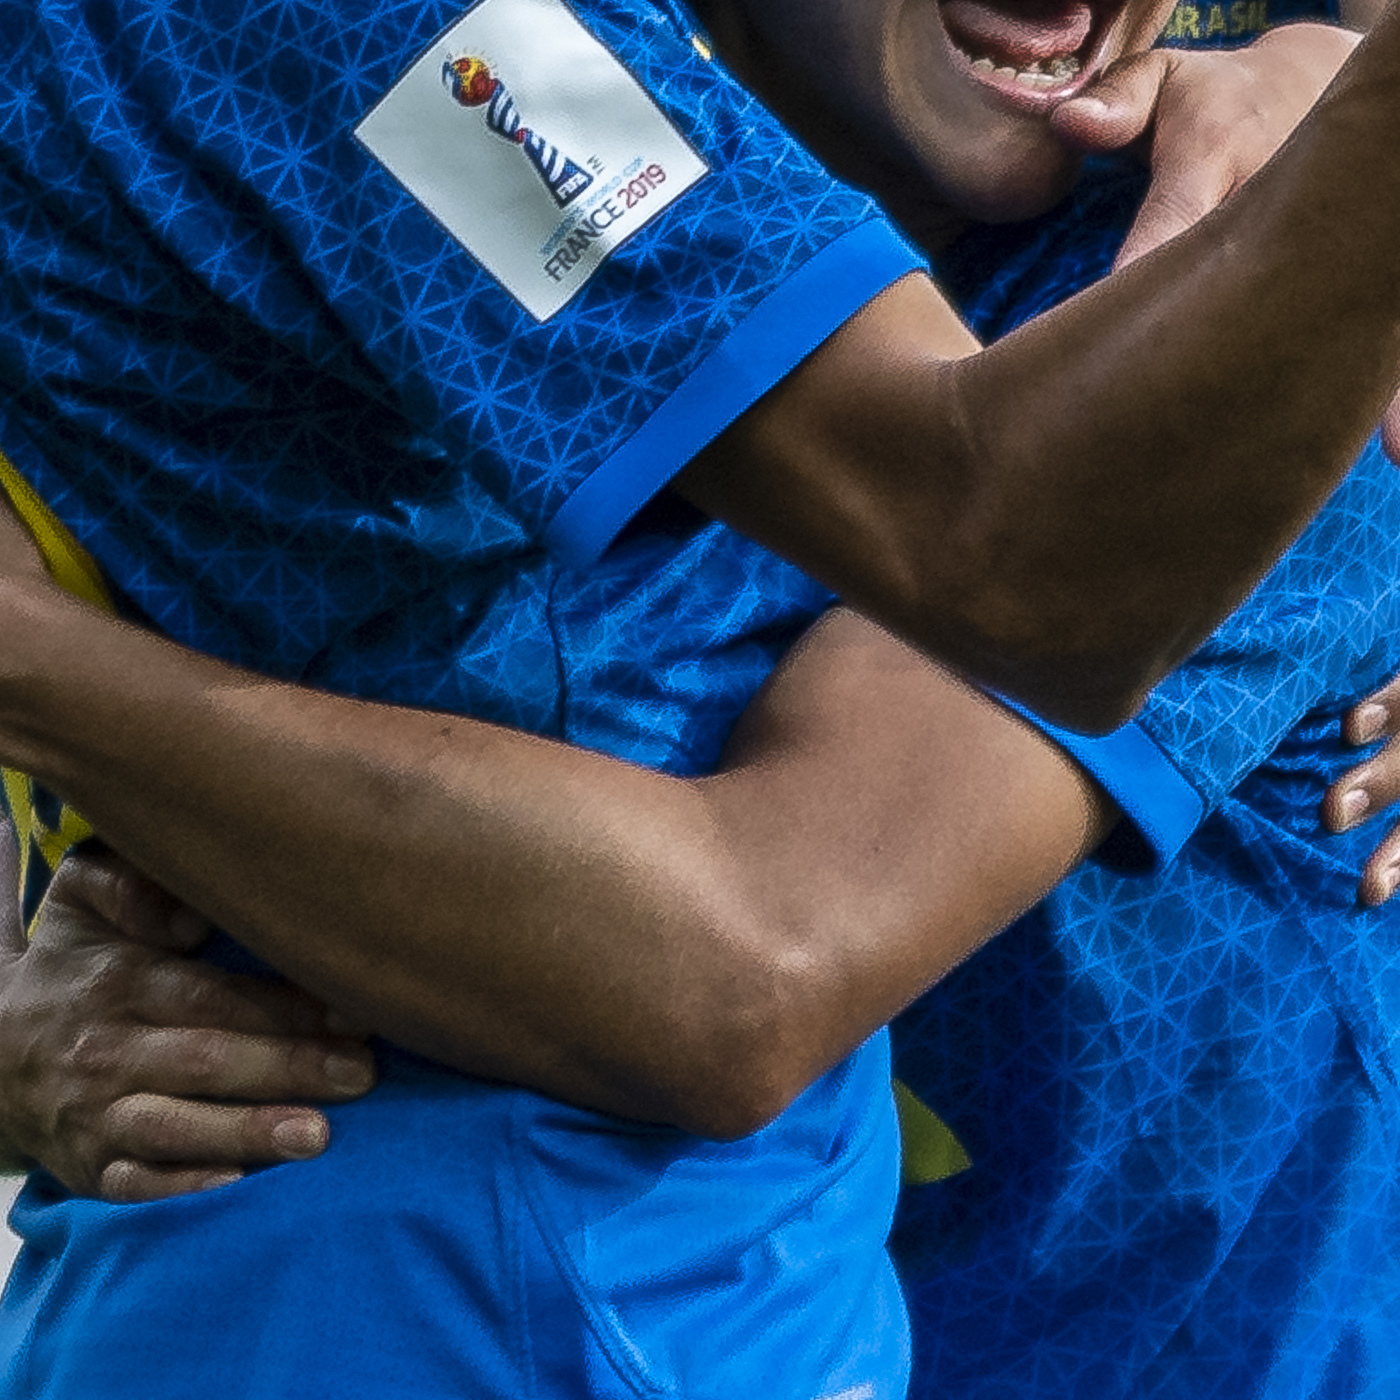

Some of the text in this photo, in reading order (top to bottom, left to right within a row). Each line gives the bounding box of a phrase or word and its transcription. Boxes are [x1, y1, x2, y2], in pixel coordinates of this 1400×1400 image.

[1166, 0, 1274, 39] RASIL
[556, 172, 588, 200] FIFA
[544, 199, 625, 282] FRANCE
[617, 163, 667, 209] 2019
